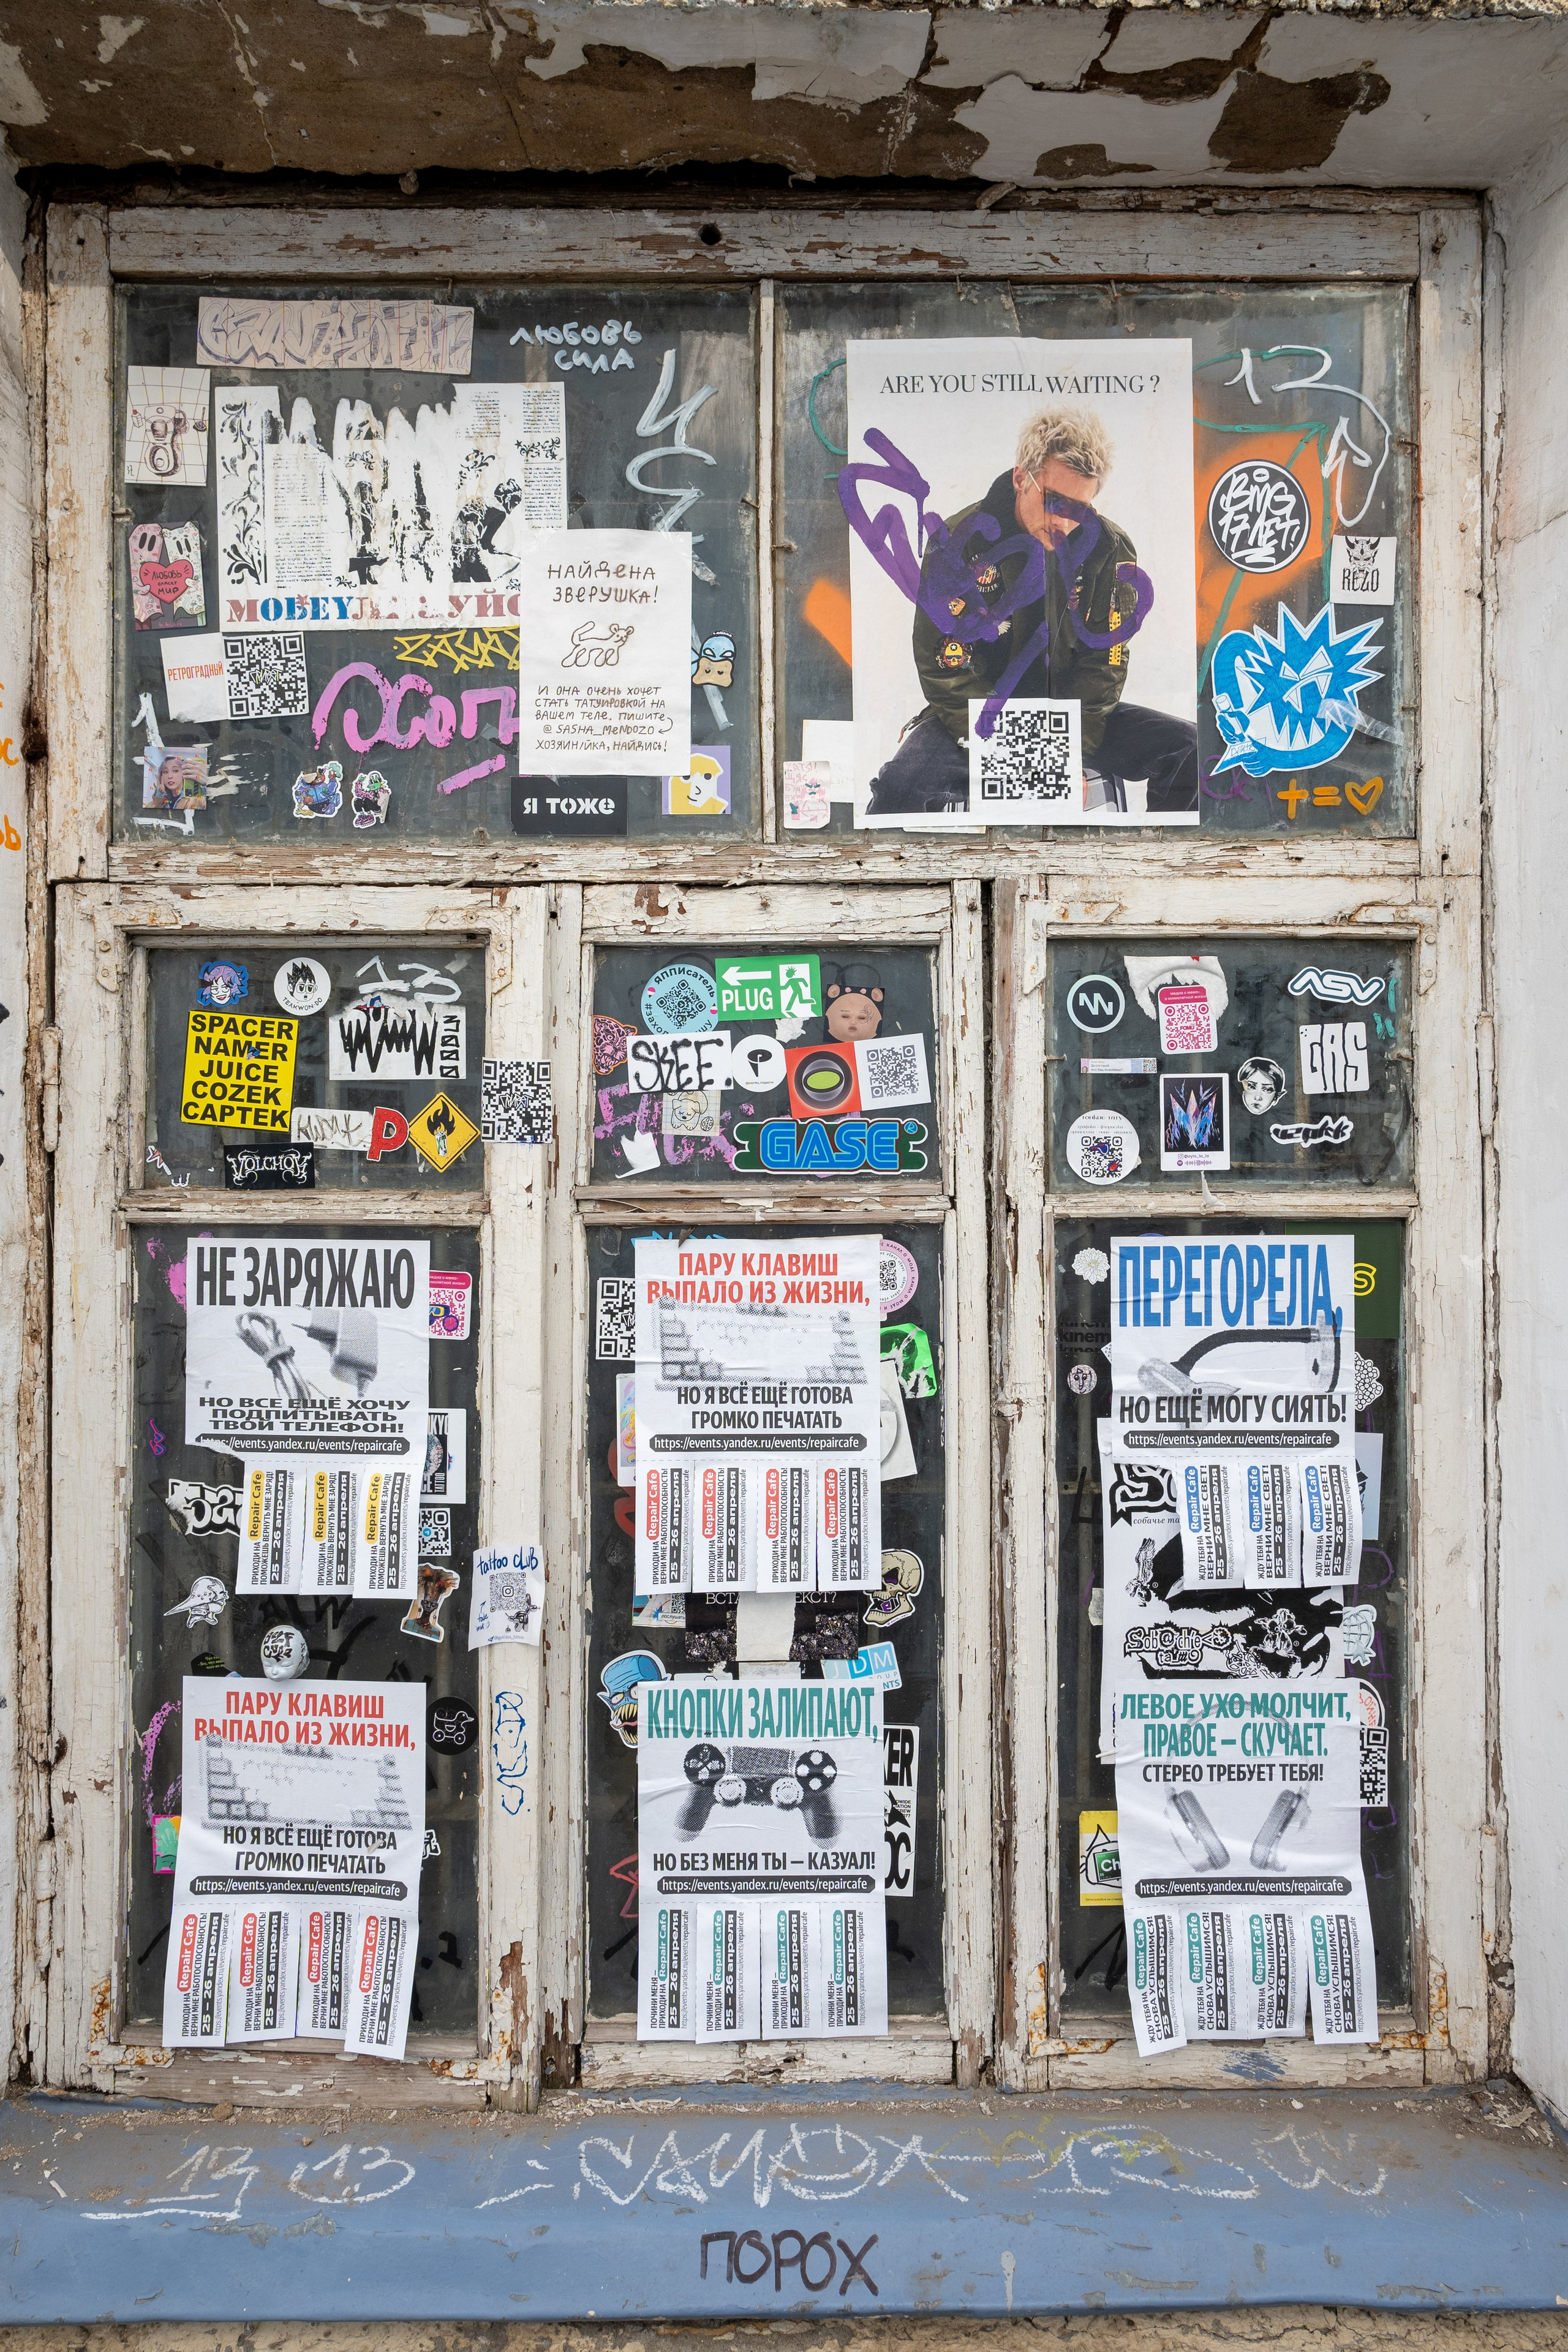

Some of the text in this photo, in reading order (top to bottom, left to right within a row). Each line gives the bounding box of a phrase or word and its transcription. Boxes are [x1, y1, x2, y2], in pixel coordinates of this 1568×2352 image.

[510, 320, 642, 346] ЛЮБОВЬ
[554, 348, 635, 374] СИЛА
[880, 375, 924, 393] ARE
[929, 375, 976, 393] YOU
[981, 374, 1042, 393] STILL
[1046, 375, 1145, 394] WAITING
[151, 569, 183, 581] ЛЮБОВЬ
[158, 587, 179, 595] МИР
[168, 661, 224, 681] РЕТРОГРАДНЫЙ
[535, 697, 666, 709] СТАТЬ ТАТУИРОВКОЙ НА
[538, 686, 549, 696] И
[556, 686, 581, 696] ОНА
[627, 686, 662, 696] ХОЧЕТ
[523, 797, 538, 815] Я
[282, 997, 323, 1011] TEAKWON-DO
[722, 988, 774, 1012] PLUG
[191, 1014, 294, 1040] SPACER
[195, 1036, 288, 1061] NAMER
[199, 1060, 278, 1084] JUICE
[192, 1081, 282, 1106] COZEK
[183, 1101, 290, 1128] CAPTEK
[760, 1121, 899, 1170] GASE
[679, 1253, 839, 1276] ПАРУ КЛАВИШ
[196, 1246, 415, 1309] НЕ ЗАРЯЖАЮ
[647, 1281, 870, 1306] ВЫПАЛО ИЗ ЖИЗНИ,
[1119, 1244, 1343, 1337] ПЕРЕГОРЕЛА,
[199, 1396, 410, 1411] НО ВСЕ ЕЩЁ ХОЧУ
[677, 1382, 853, 1408] НО Я ВСЁ ЕЩЁ ГОТОВА
[212, 1408, 397, 1422] ПОДПИТЫВАТЬ
[692, 1411, 842, 1429] ГРОМКО ПЕЧАТАТЬ
[1120, 1388, 1347, 1428] НО ЕЩЁ МОГУ СИЯТЬ!
[209, 1417, 404, 1433] ТВОЙ ТЕЛЕФОН!
[654, 1436, 859, 1450] https://events.yandex.ru/events/repaircafe
[1128, 1433, 1332, 1447] https://events.yandex.ru/events/repaircafe
[434, 1472, 445, 1493] TATTOO
[1200, 1465, 1208, 1501] СВЕТ!
[649, 1472, 658, 1537] Repair Cafe
[250, 1474, 262, 1585] ПРИХОДИ НА Repair Cafe
[262, 1512, 271, 1542] ВЕРНУТЬ
[271, 1473, 284, 1581] 25 26 апреля
[1202, 1504, 1210, 1532] МНЕ
[1197, 1536, 1204, 1546] НА
[260, 1543, 269, 1585] ПОМОЖЕШЬ
[477, 1552, 508, 1575] tattoo
[795, 1592, 837, 1604] ЕКСТ?
[225, 1691, 385, 1719] ПАРУ КЛАВИШ
[648, 1687, 878, 1744] КНОПКИ ЗАЛИПАЮТ,
[1120, 1692, 1351, 1722] ЛЕВОЕ УХО МОЛЧИТ,
[194, 1718, 416, 1751] ВЫПАЛО ИЗ ЖИЗНИ,
[1144, 1724, 1217, 1757] ПРАВОЕ
[1241, 1722, 1328, 1757] СКУЧАЕТ.
[1143, 1764, 1324, 1782] СТЕРЕО ТРЕБУЕТ ТЕБЯ!
[224, 1823, 398, 1850] НО Я ВСЁ ЕЩЁ ГОТОВА
[235, 1851, 386, 1875] ГРОМКО ПЕЧАТАТЬ
[654, 1852, 676, 1871] НО
[680, 1852, 709, 1871] БЕЗ
[713, 1852, 757, 1871] МЕНЯ
[761, 1852, 786, 1871] ТЫ
[808, 1851, 875, 1870] КАЗУАЛ!
[194, 1877, 401, 1897] https://events.yandex.ru/events/repaircafe
[662, 1877, 868, 1891] https://events.yandex.ru/events/repaircafe
[1140, 1880, 1343, 1894] https://events.yandex.ru/events/repaircafe
[700, 2230, 881, 2297] ПОРОХ
